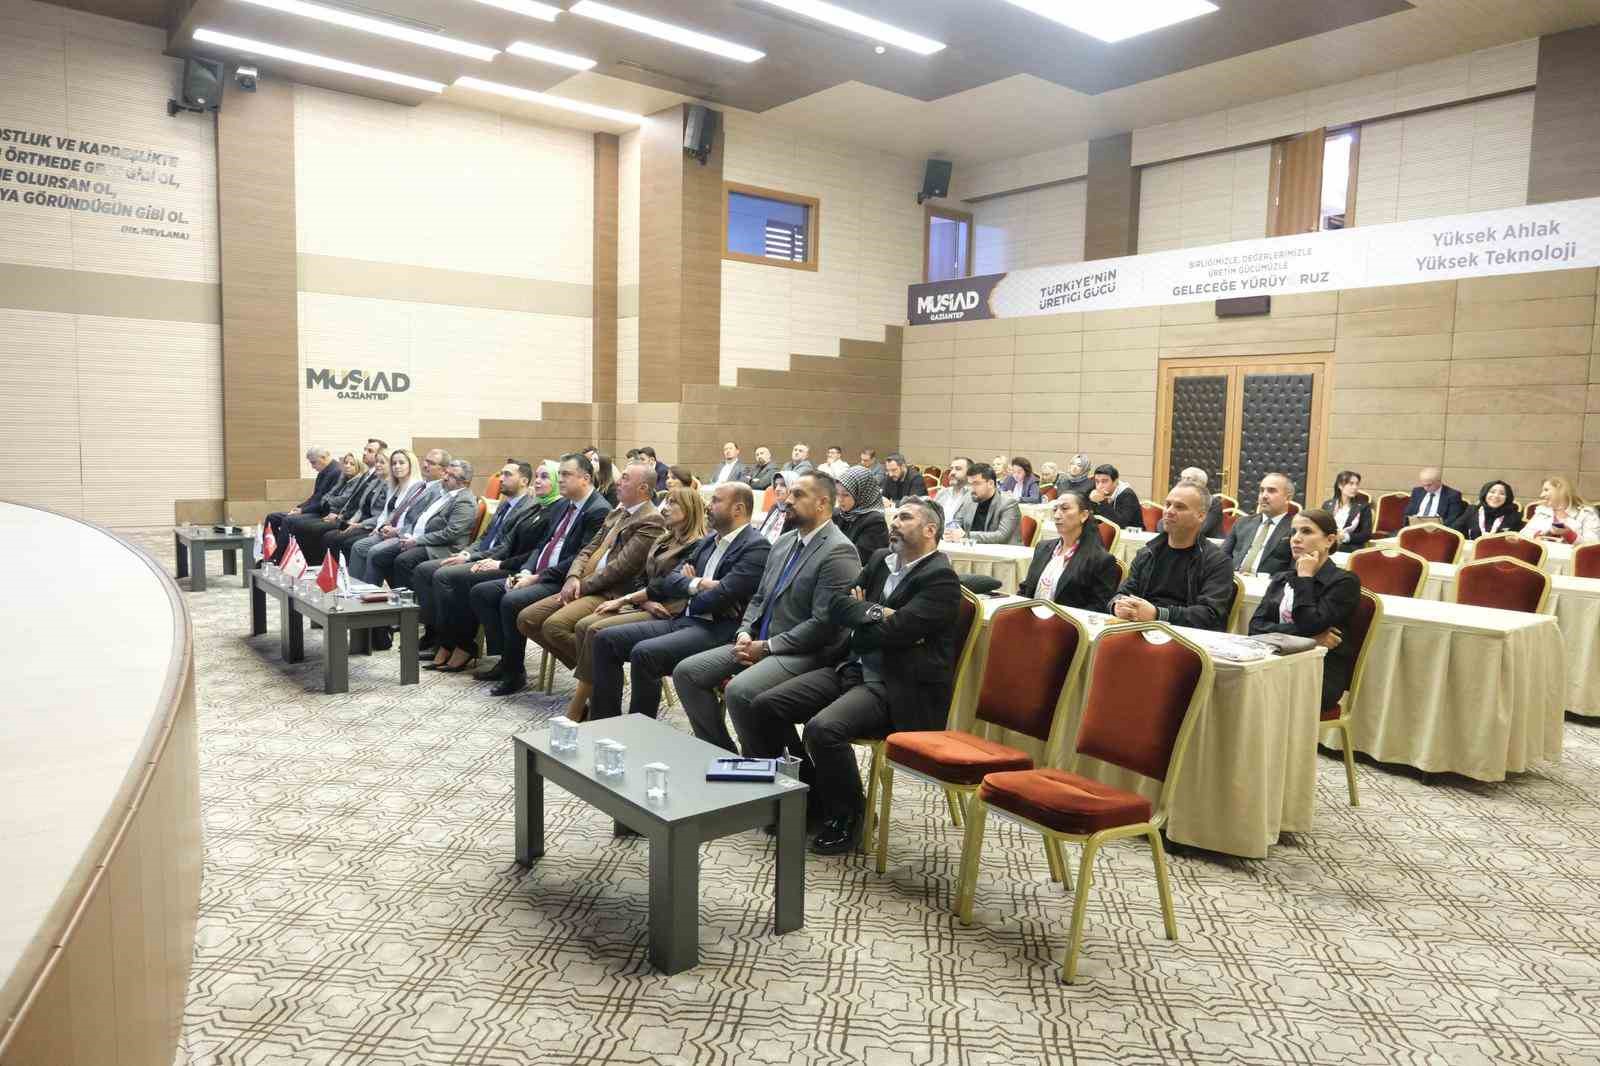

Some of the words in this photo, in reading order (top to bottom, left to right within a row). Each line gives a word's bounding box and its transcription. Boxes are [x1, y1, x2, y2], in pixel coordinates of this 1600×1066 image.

[0, 127, 52, 148] STLUK
[56, 137, 76, 152] VE
[5, 146, 81, 172] ÖRTMEDE
[16, 171, 90, 192] OLURSAN
[1432, 227, 1497, 247] Yüksek
[1503, 219, 1561, 241] Ahlak
[1416, 254, 1479, 271] Yüksek
[1485, 242, 1577, 264] Teknoloji
[1083, 282, 1116, 299] GÜCÜ
[1172, 279, 1238, 296] GELECEĞE
[1240, 271, 1330, 290] YÜRÜYRUZ
